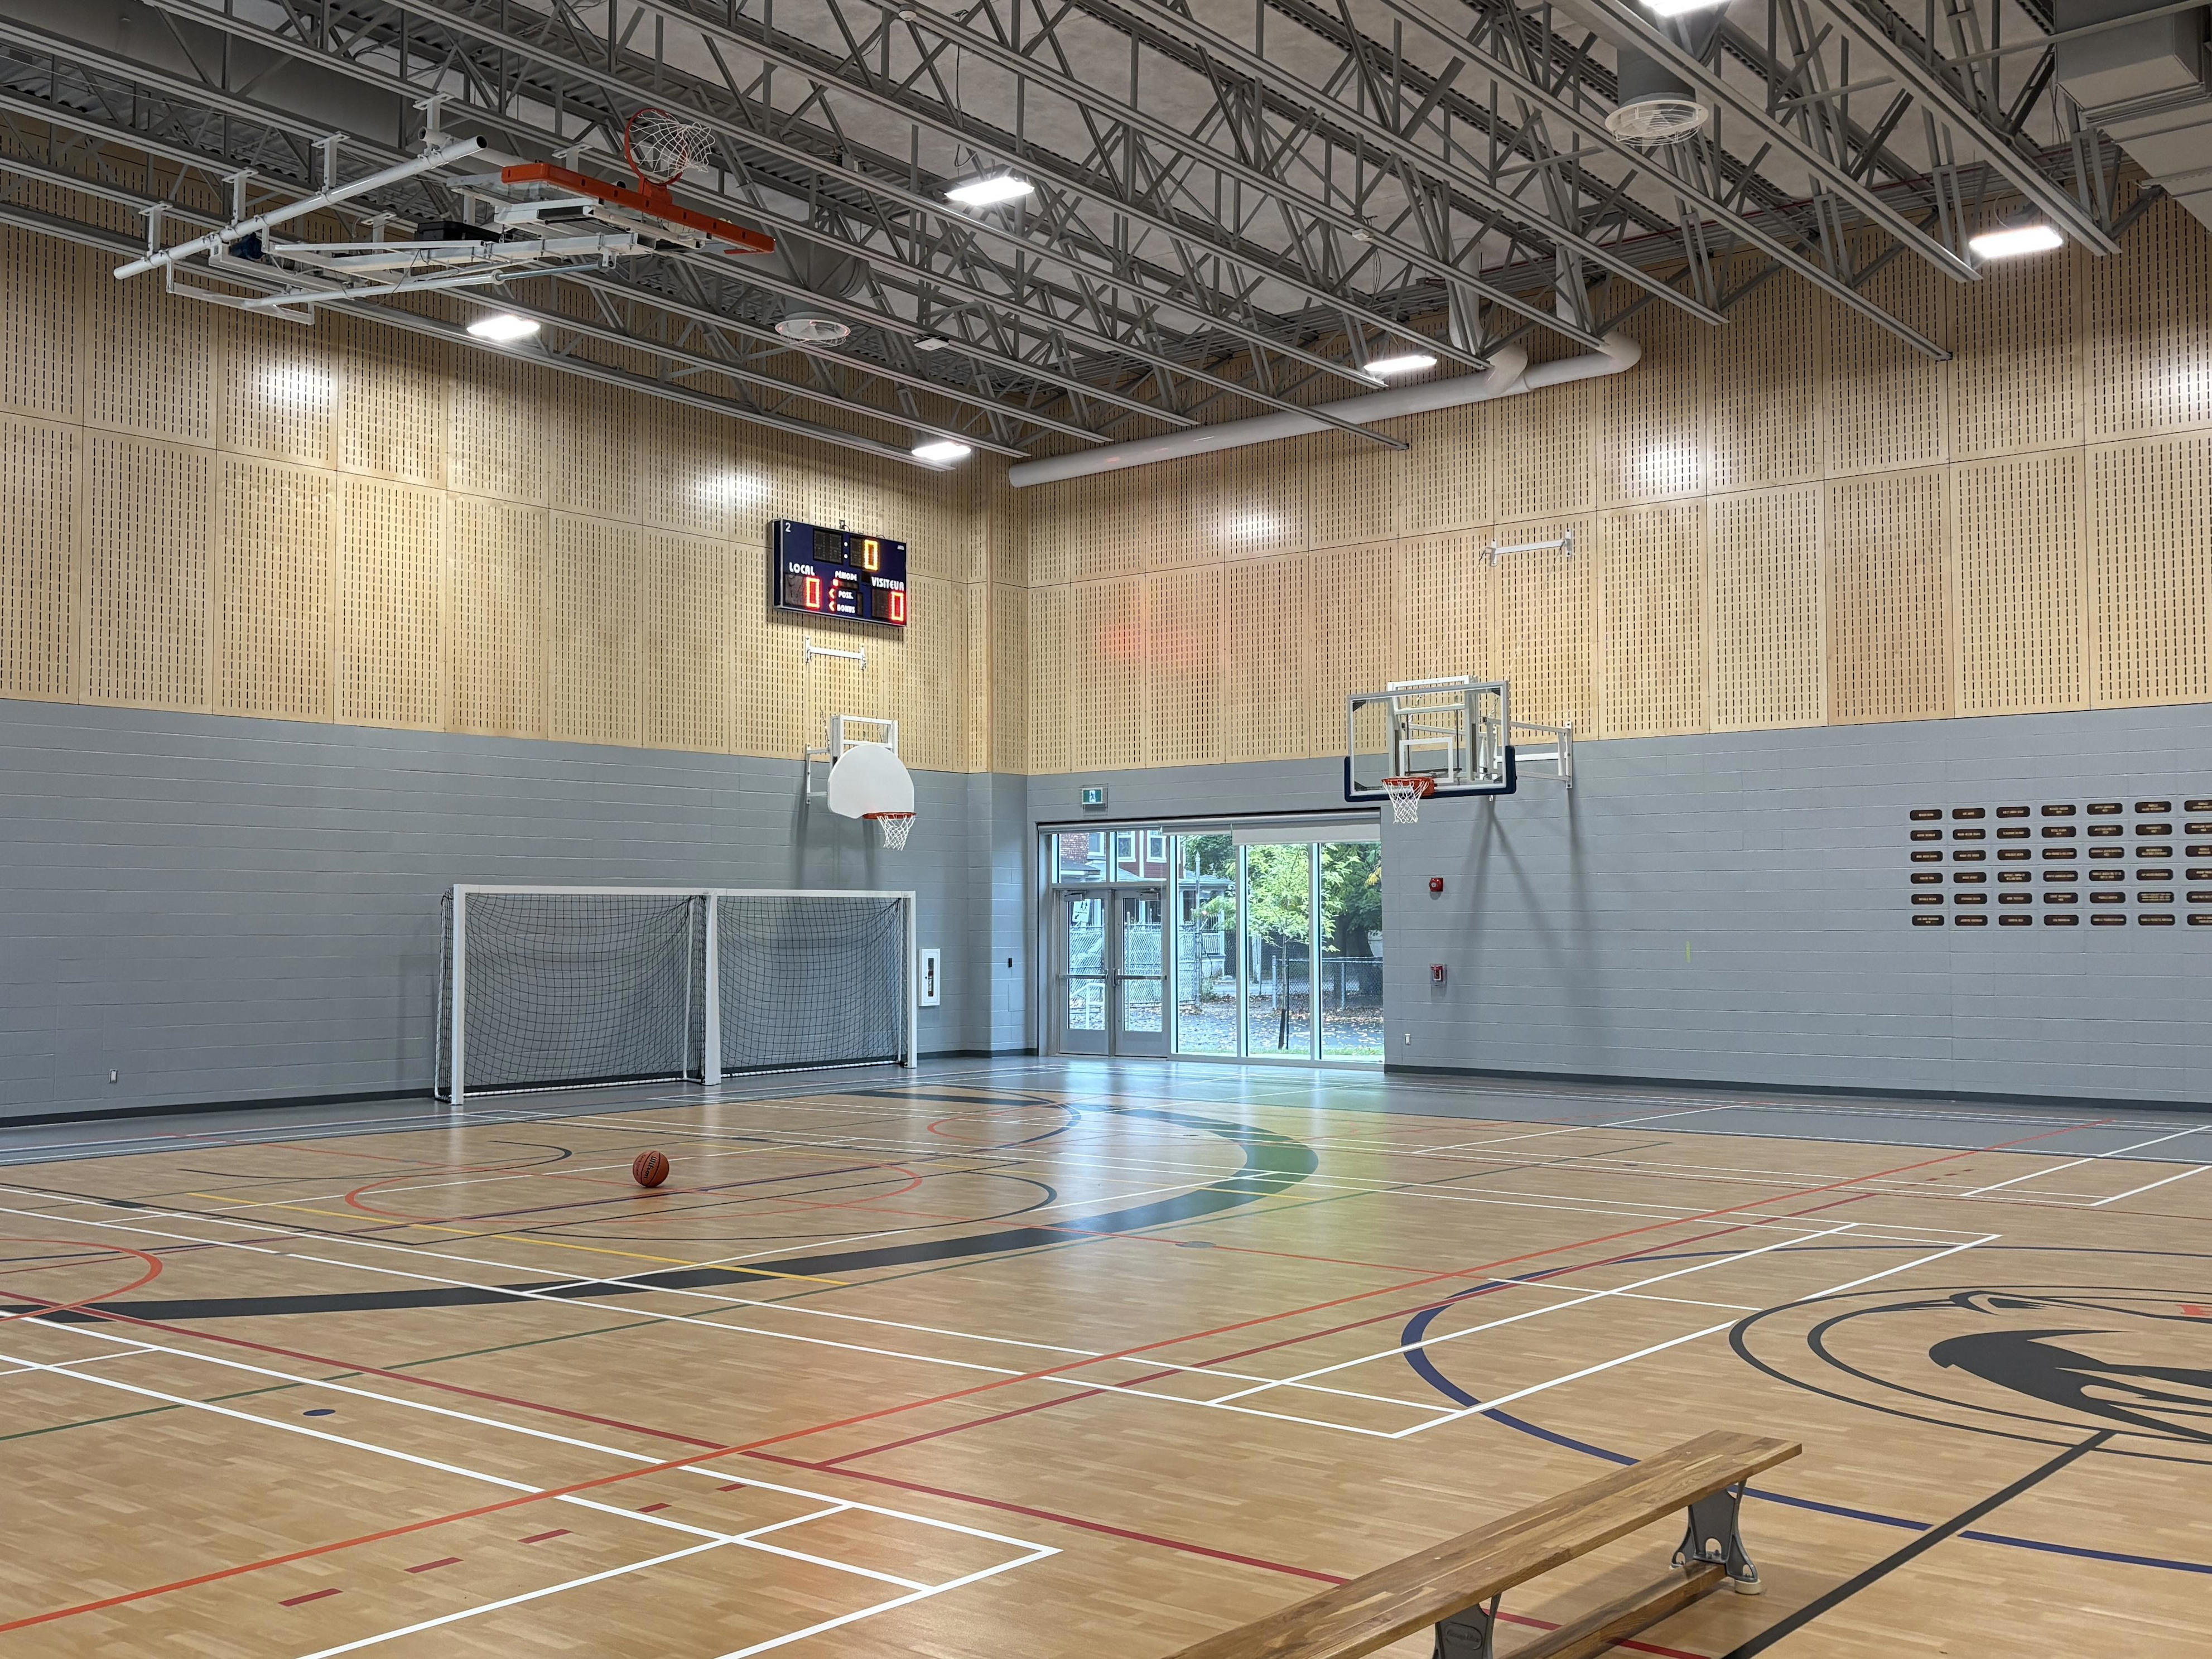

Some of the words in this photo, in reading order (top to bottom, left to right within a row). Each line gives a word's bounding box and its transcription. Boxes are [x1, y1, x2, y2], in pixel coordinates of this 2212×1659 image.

[785, 522, 791, 532] 2
[789, 562, 815, 576] LOCAL
[871, 576, 904, 591] VISITEUR
[837, 604, 855, 614] BONUS
